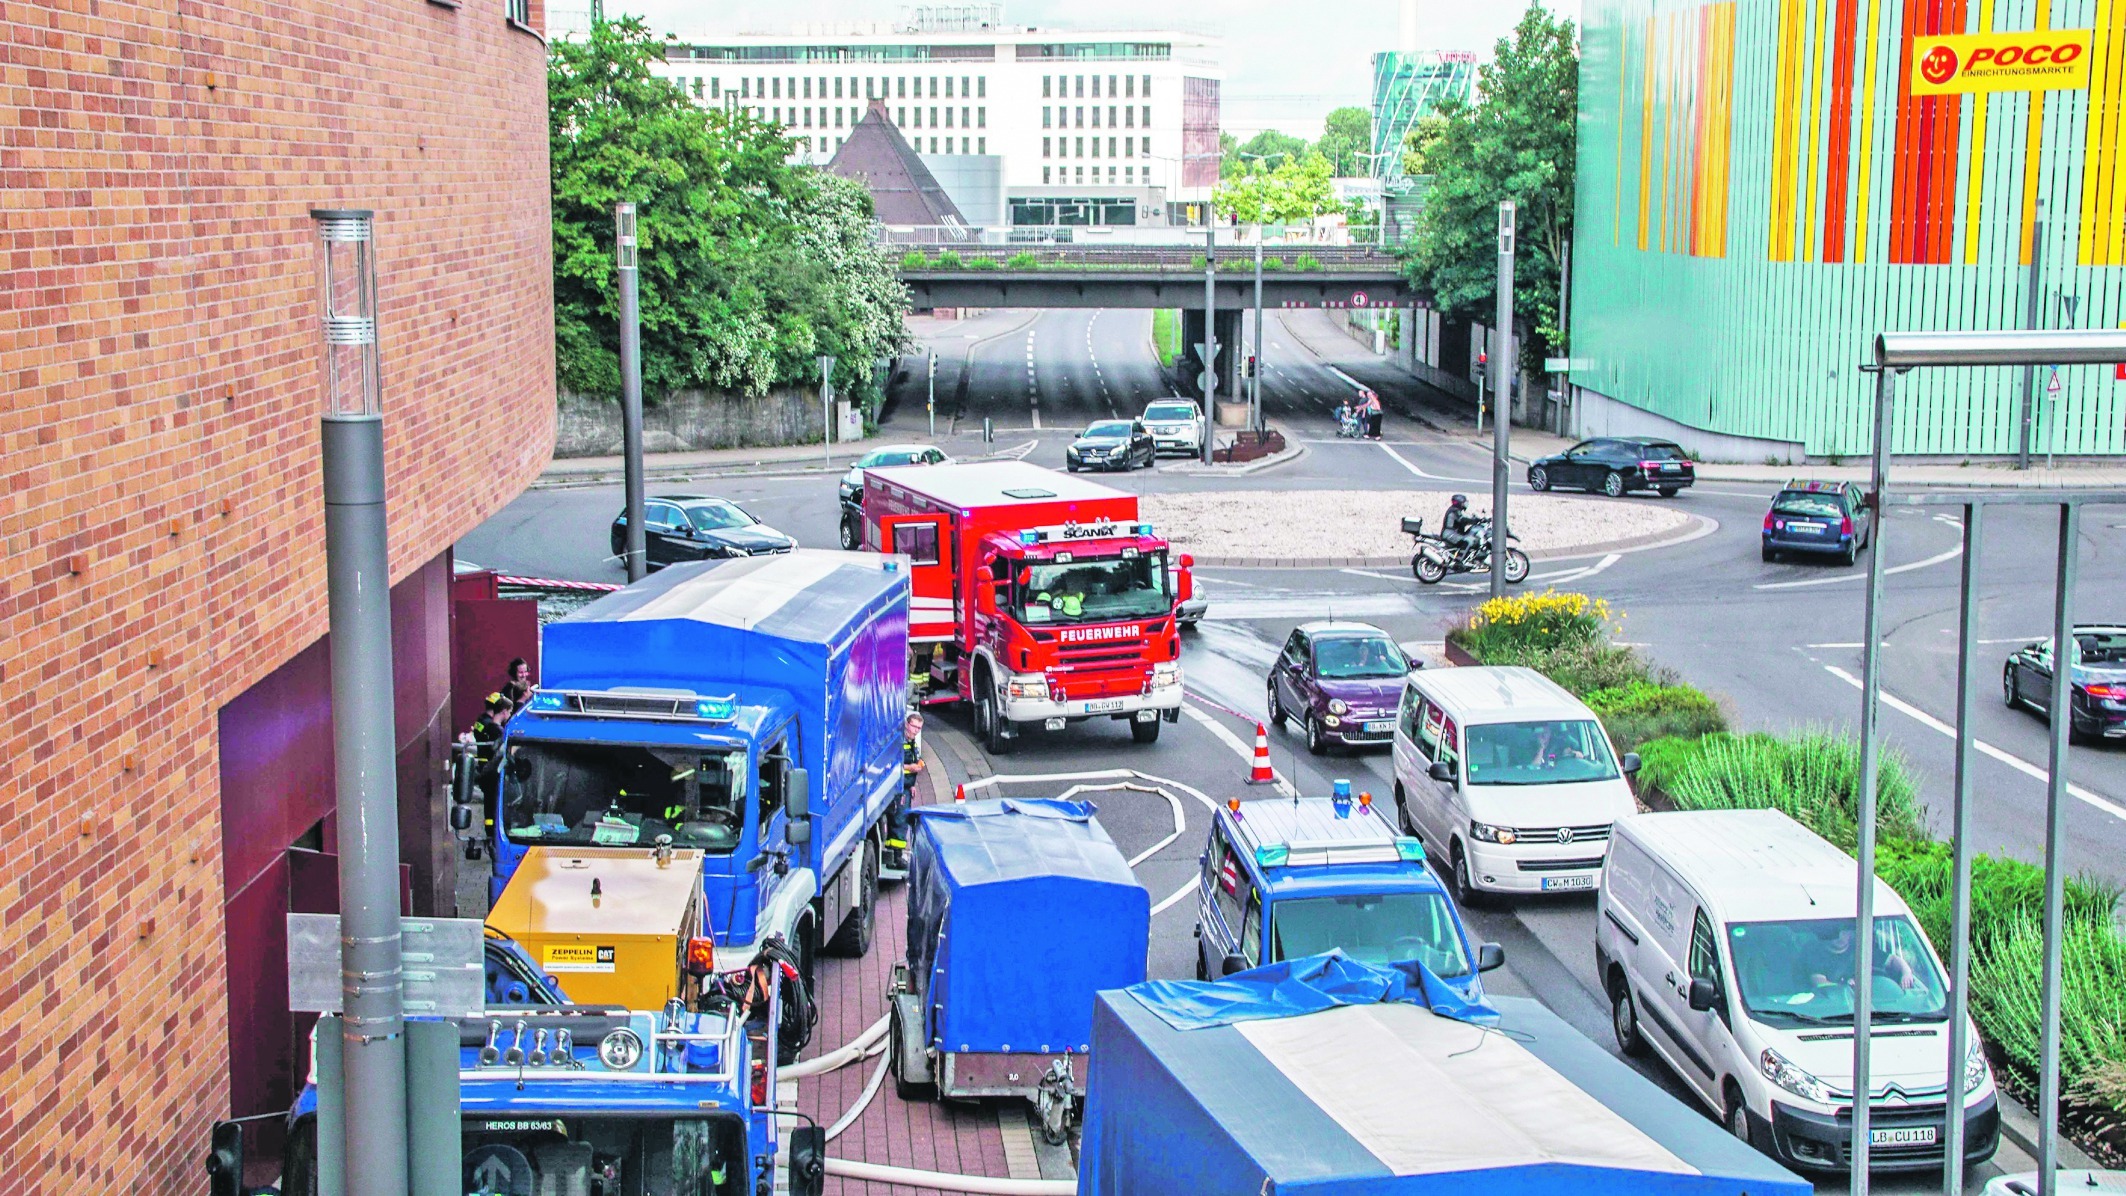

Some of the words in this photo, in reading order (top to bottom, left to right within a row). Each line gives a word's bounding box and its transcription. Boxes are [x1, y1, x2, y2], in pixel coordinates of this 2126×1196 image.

[1964, 43, 2082, 70] POCO
[1063, 527, 1114, 539] SCANIA
[1060, 625, 1140, 642] FEUERWEHR
[1547, 879, 1559, 888] CW
[1563, 878, 1570, 887] M
[598, 949, 614, 960] CAT
[485, 1121, 516, 1130] HEROS
[517, 1121, 529, 1130] BB
[530, 1121, 552, 1130] 63/63
[1872, 1132, 1888, 1143] LB
[1895, 1131, 1910, 1142] CU
[1912, 1129, 1934, 1141] 118
